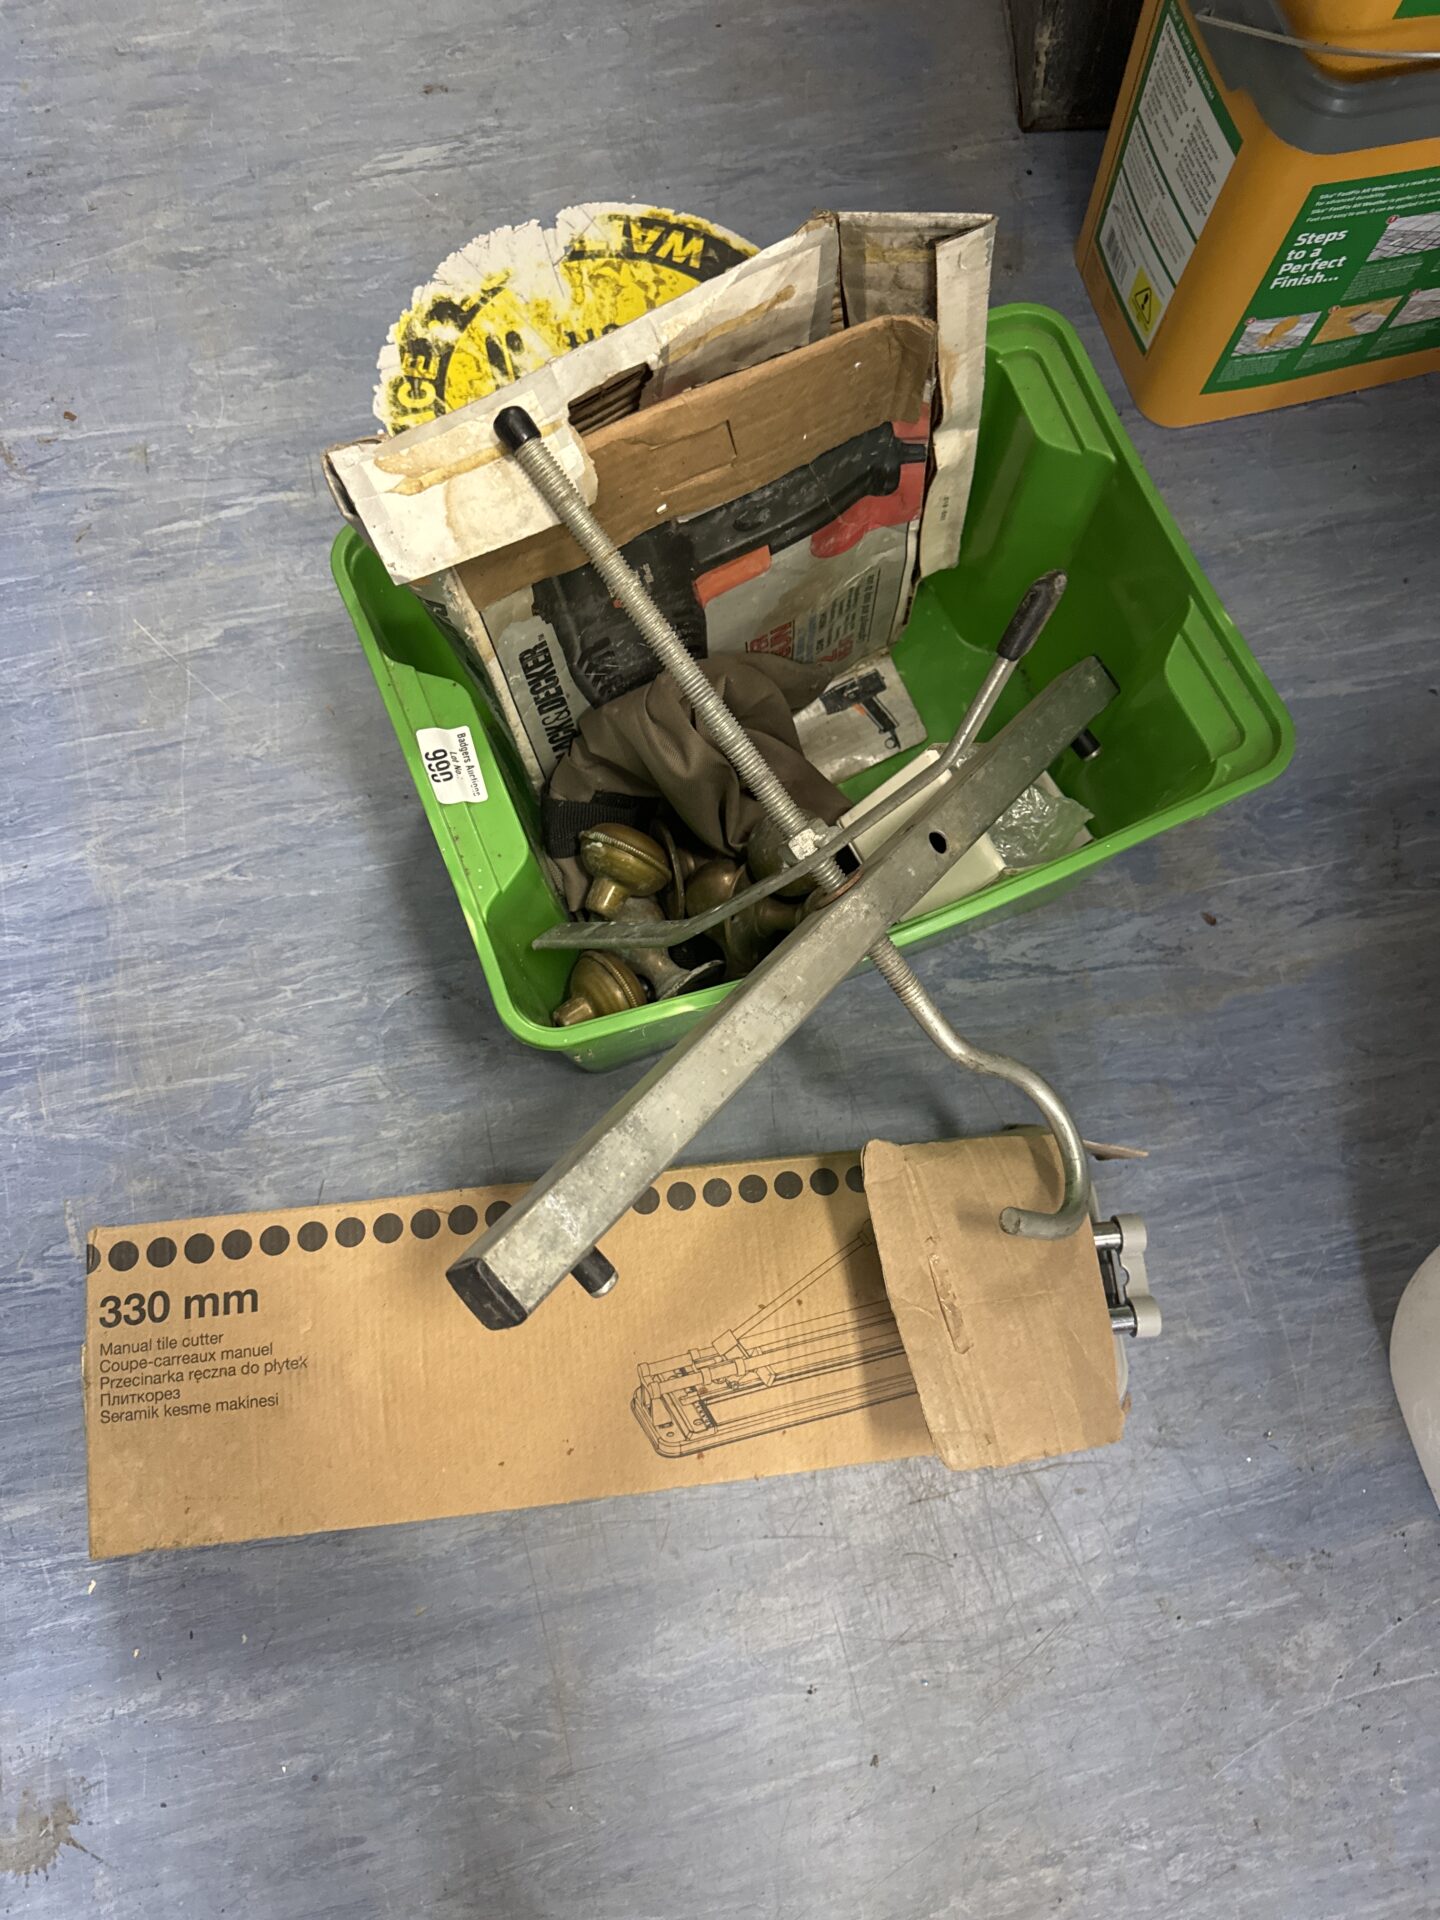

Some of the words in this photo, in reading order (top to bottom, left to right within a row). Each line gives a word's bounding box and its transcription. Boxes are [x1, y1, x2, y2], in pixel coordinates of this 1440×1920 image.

[1293, 230, 1349, 246] Steps
[1277, 256, 1347, 275] Perfect
[1286, 249, 1307, 261] to
[1309, 248, 1323, 257] a
[1269, 271, 1339, 289] Finish...
[424, 749, 454, 783] 990
[450, 751, 459, 763] Lot
[457, 732, 471, 763] Badgers
[465, 765, 481, 797] Auctions
[99, 1290, 170, 1328] 330
[184, 1288, 259, 1320] mm
[100, 1339, 152, 1356] Manual
[157, 1336, 177, 1351] tile
[182, 1333, 224, 1348] cutter
[100, 1350, 216, 1374] Coupe-carreaux
[221, 1342, 273, 1360] manuel
[100, 1370, 184, 1390] Przecinarka
[189, 1366, 236, 1383] ręczna
[241, 1361, 259, 1376] do
[264, 1355, 308, 1376] płytek
[100, 1388, 181, 1407] Плиткорез
[100, 1405, 159, 1424] Seramik
[164, 1401, 211, 1417] kesme
[215, 1392, 280, 1412] makinesi
